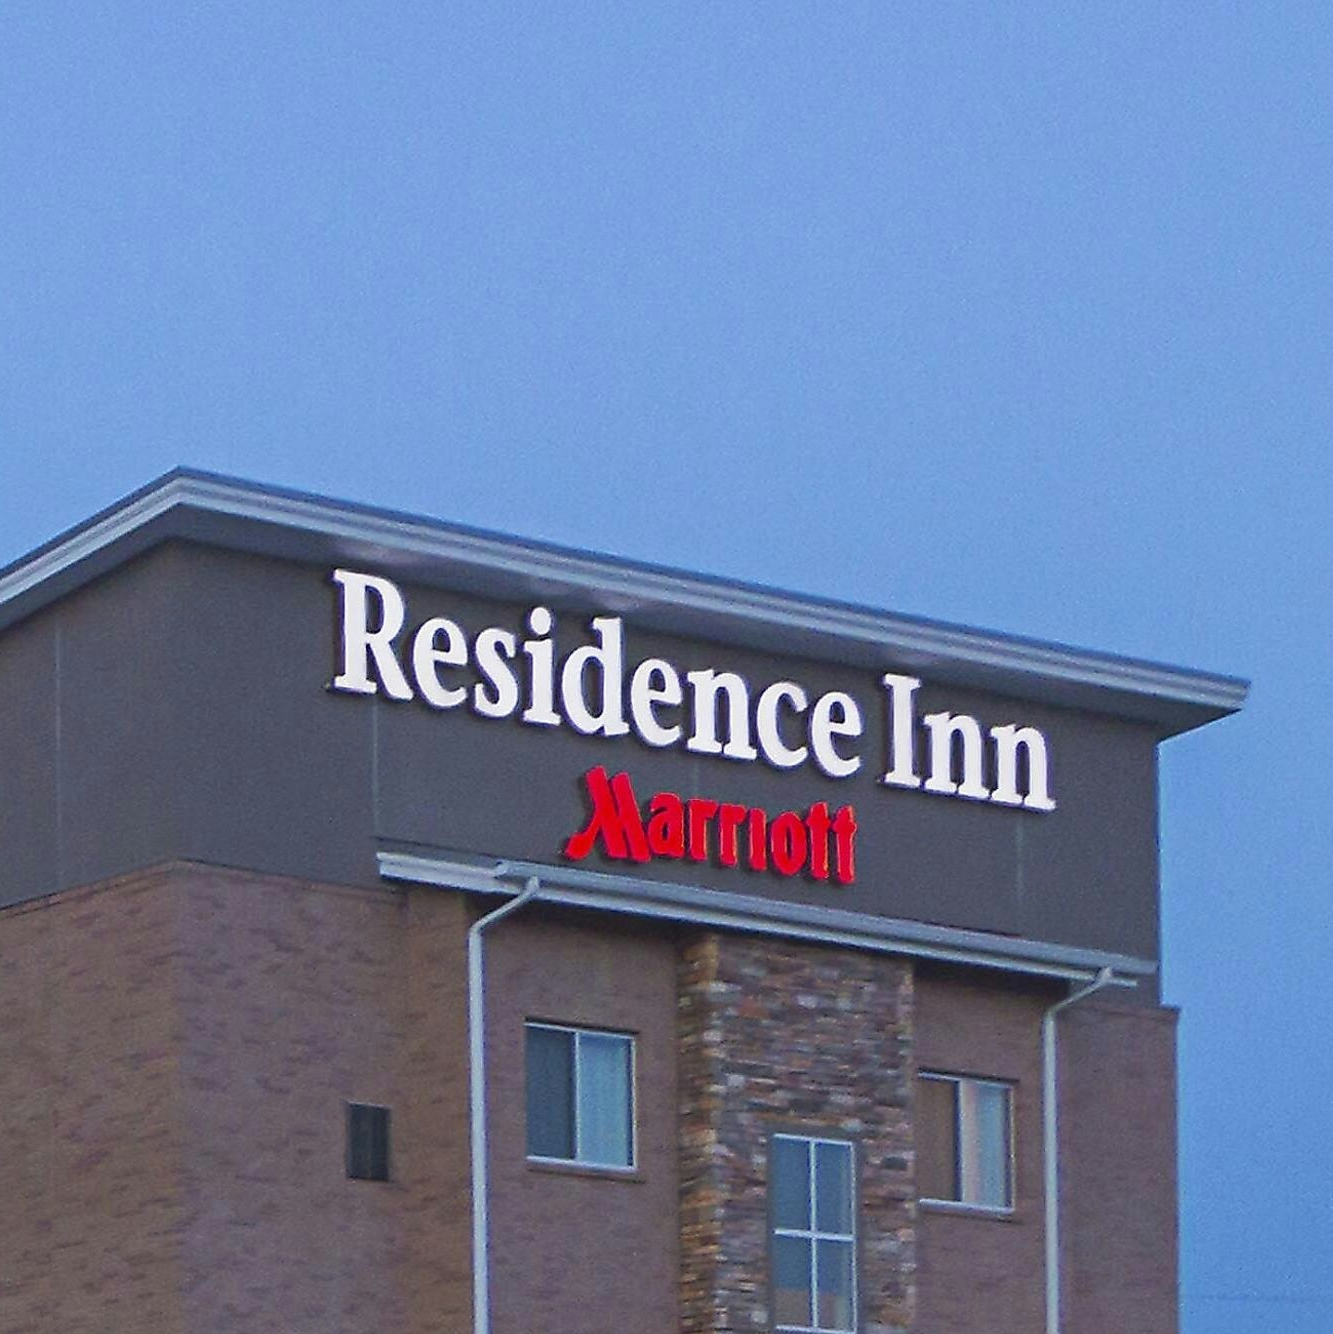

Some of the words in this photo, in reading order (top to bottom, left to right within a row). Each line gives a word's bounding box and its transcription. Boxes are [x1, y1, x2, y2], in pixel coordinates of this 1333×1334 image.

[333, 568, 862, 777] Residence
[883, 673, 1057, 810] Inn
[565, 766, 858, 884] Marriott
